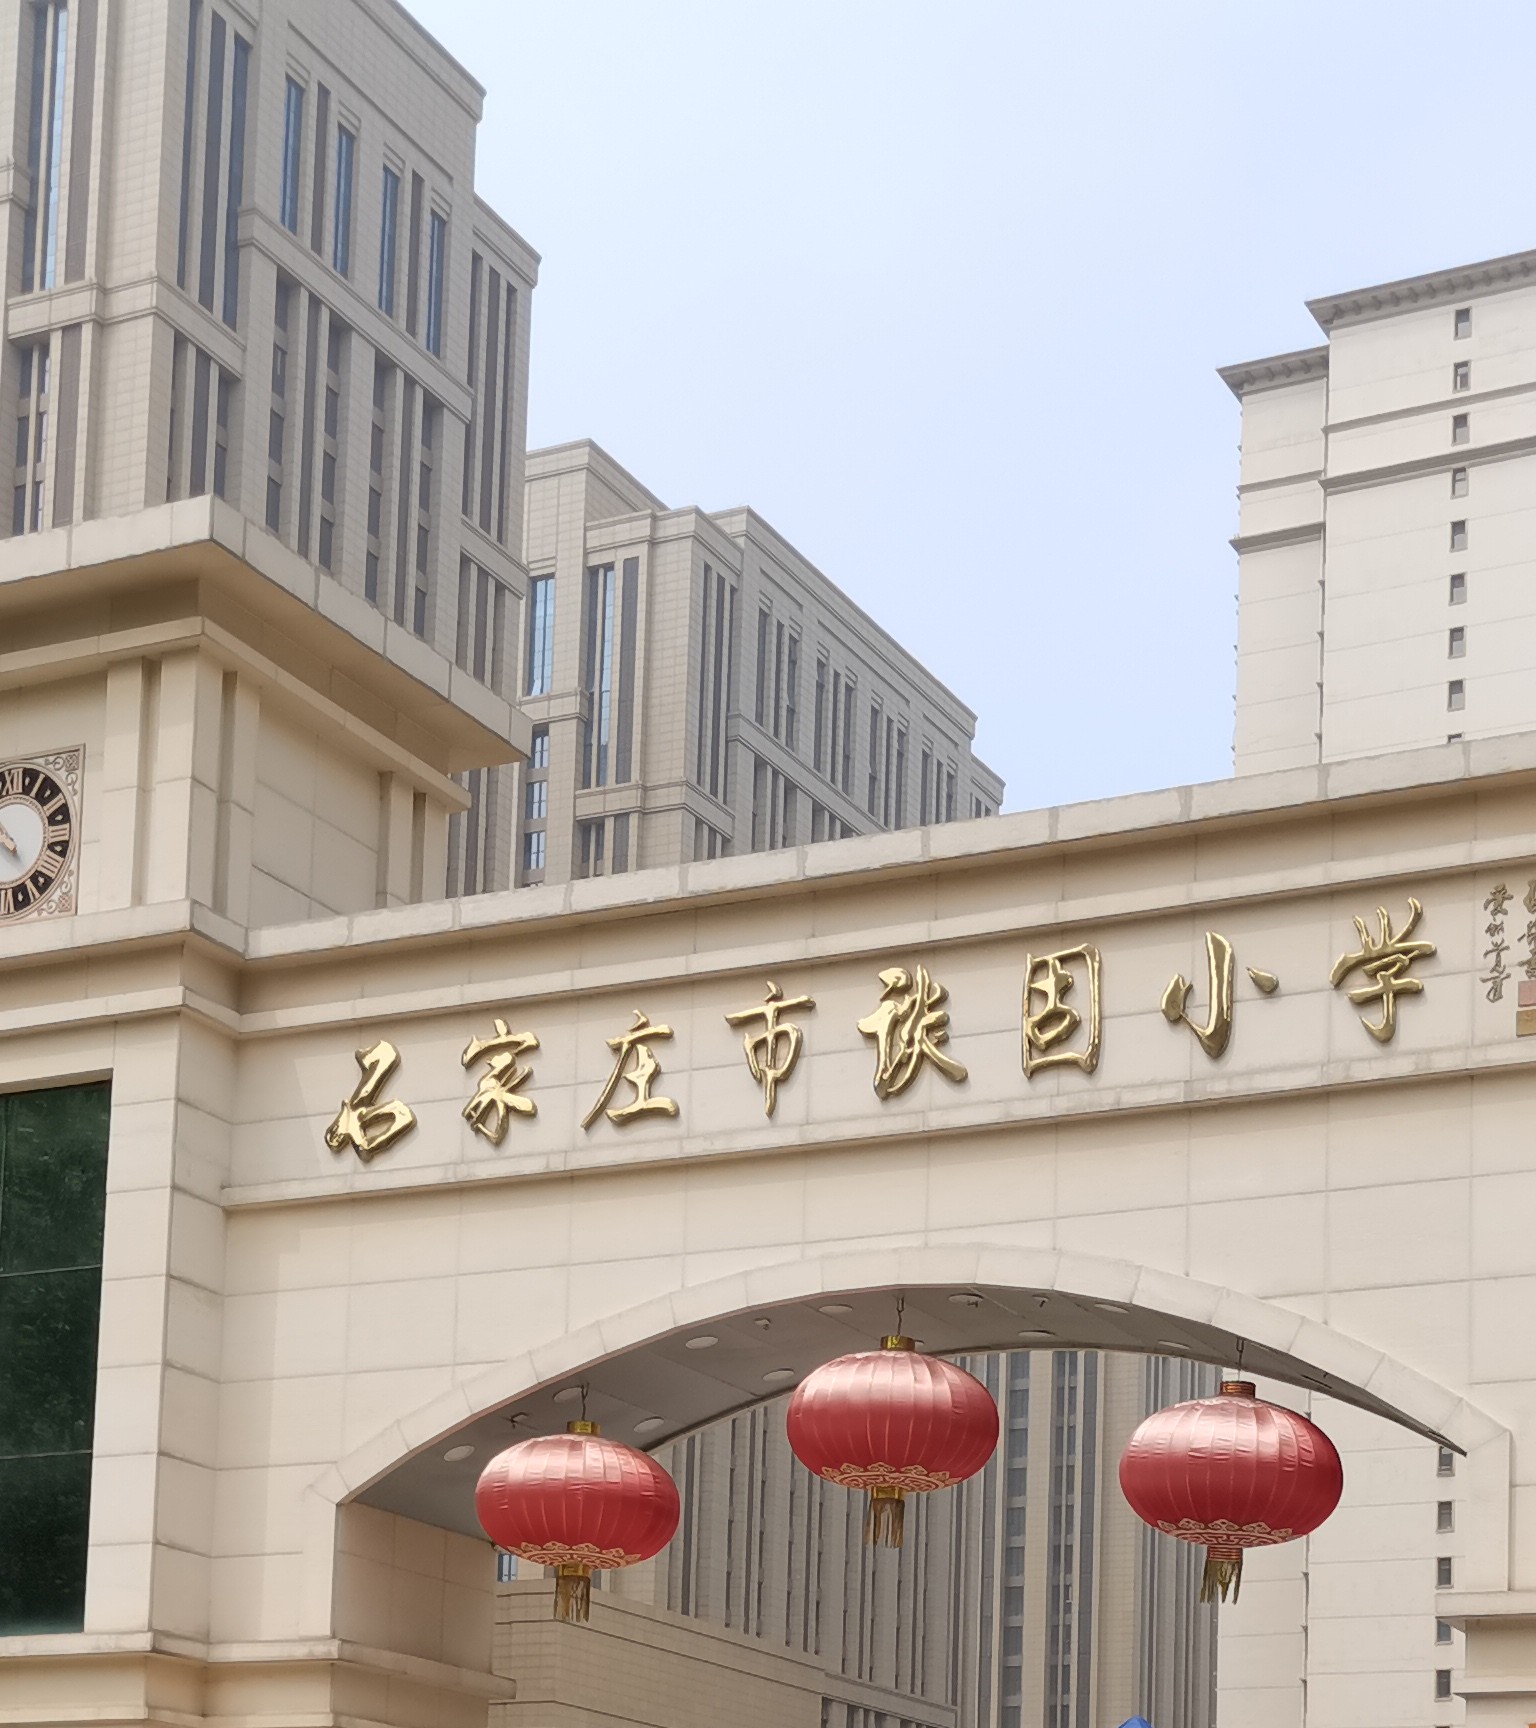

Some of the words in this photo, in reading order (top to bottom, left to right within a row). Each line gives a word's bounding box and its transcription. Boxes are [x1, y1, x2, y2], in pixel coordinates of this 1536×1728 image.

[2, 768, 24, 796] XII
[48, 823, 70, 842] III
[323, 896, 1439, 1164] 石家庄市谈固小学
